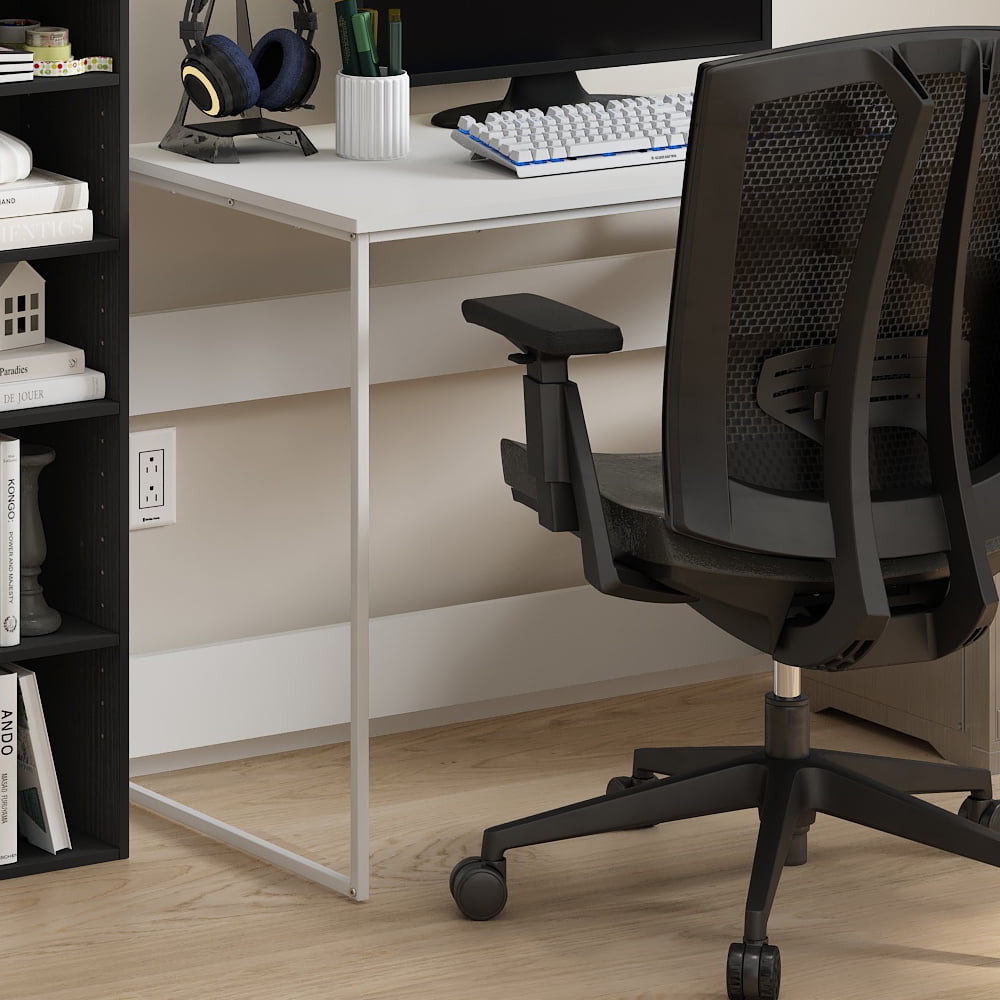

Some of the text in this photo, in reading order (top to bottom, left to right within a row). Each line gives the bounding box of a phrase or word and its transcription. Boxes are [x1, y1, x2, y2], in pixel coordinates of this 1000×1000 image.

[0, 365, 29, 376] Paradies
[4, 394, 15, 404] DE
[17, 390, 45, 404] JOUER
[7, 478, 16, 523] KONGO:
[1, 710, 14, 756] ANDO
